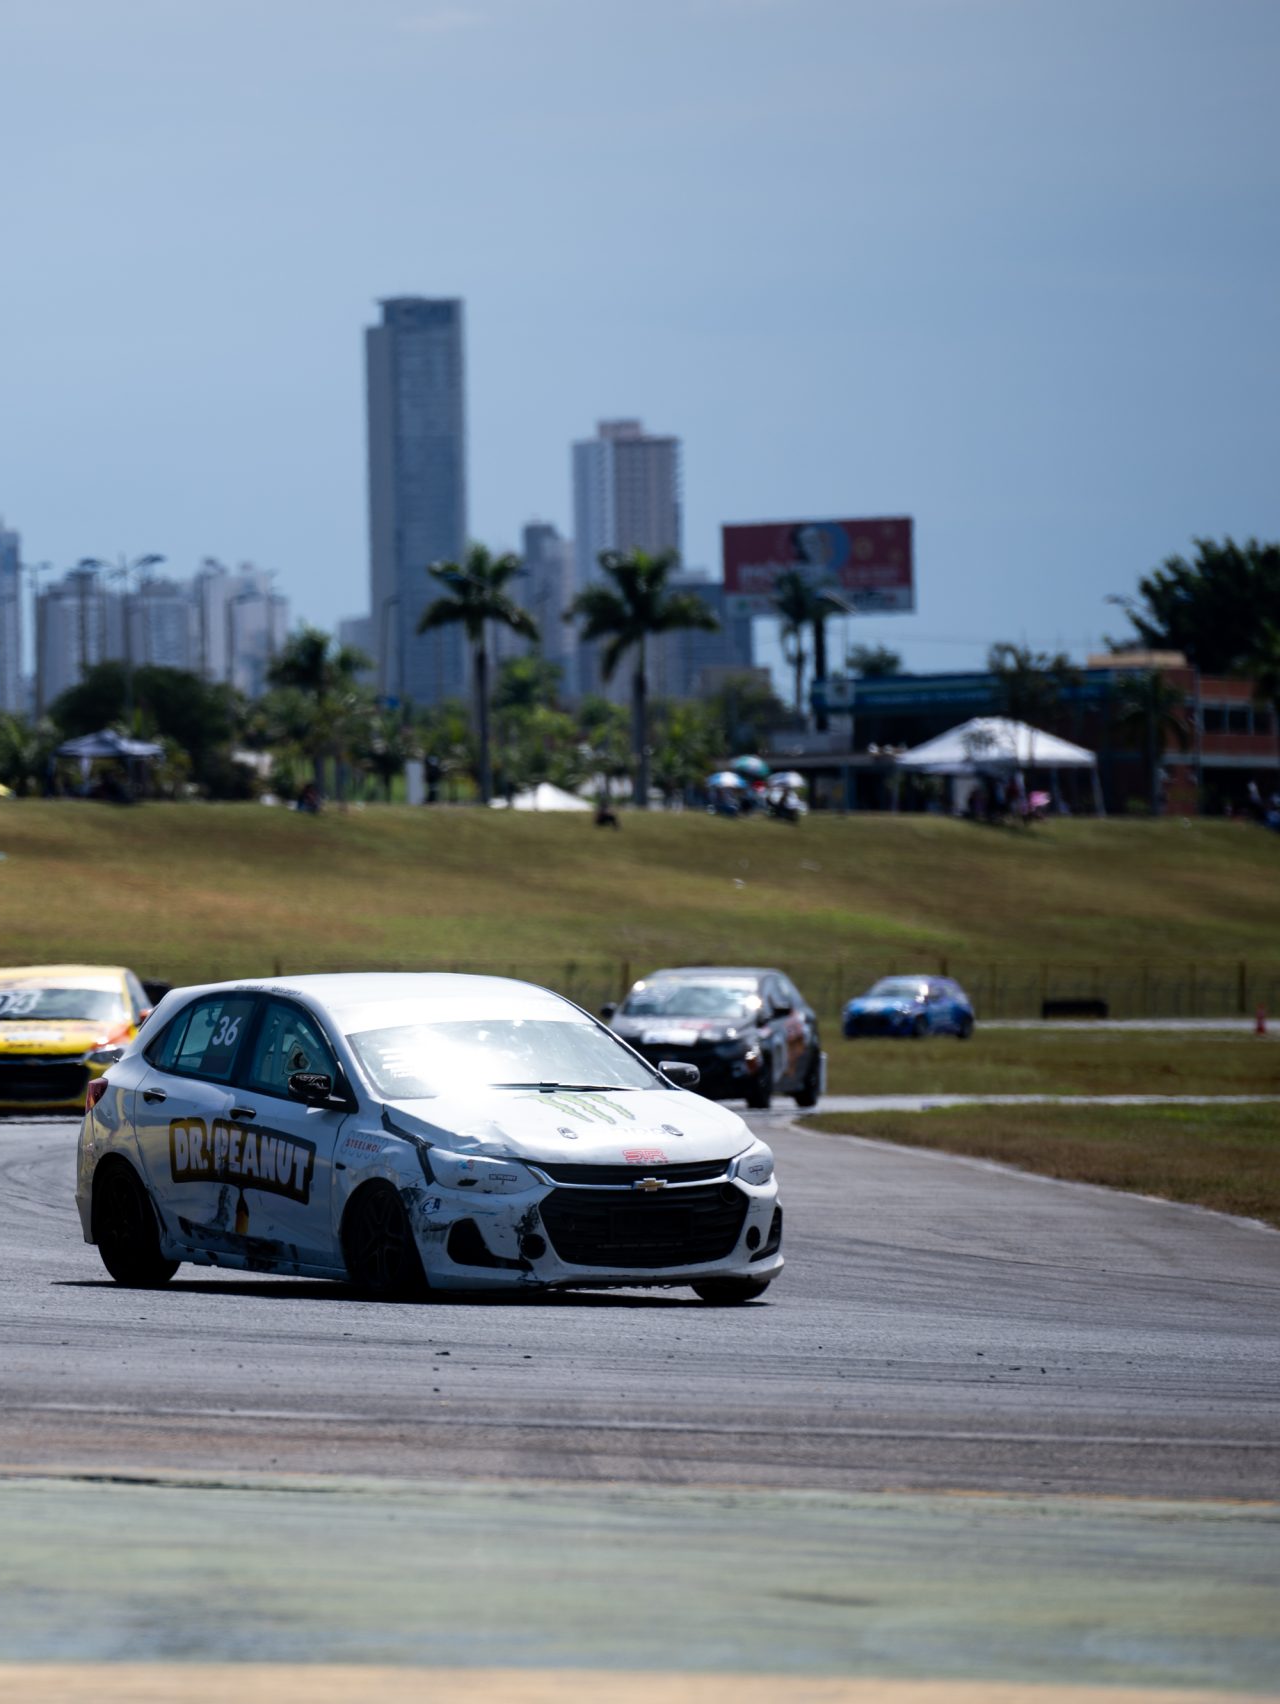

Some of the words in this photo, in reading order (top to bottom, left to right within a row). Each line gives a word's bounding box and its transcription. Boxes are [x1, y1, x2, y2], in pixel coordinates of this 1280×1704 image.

[211, 1015, 242, 1047] 36
[174, 1126, 209, 1171] DR.
[214, 1127, 311, 1192] PEANUT
